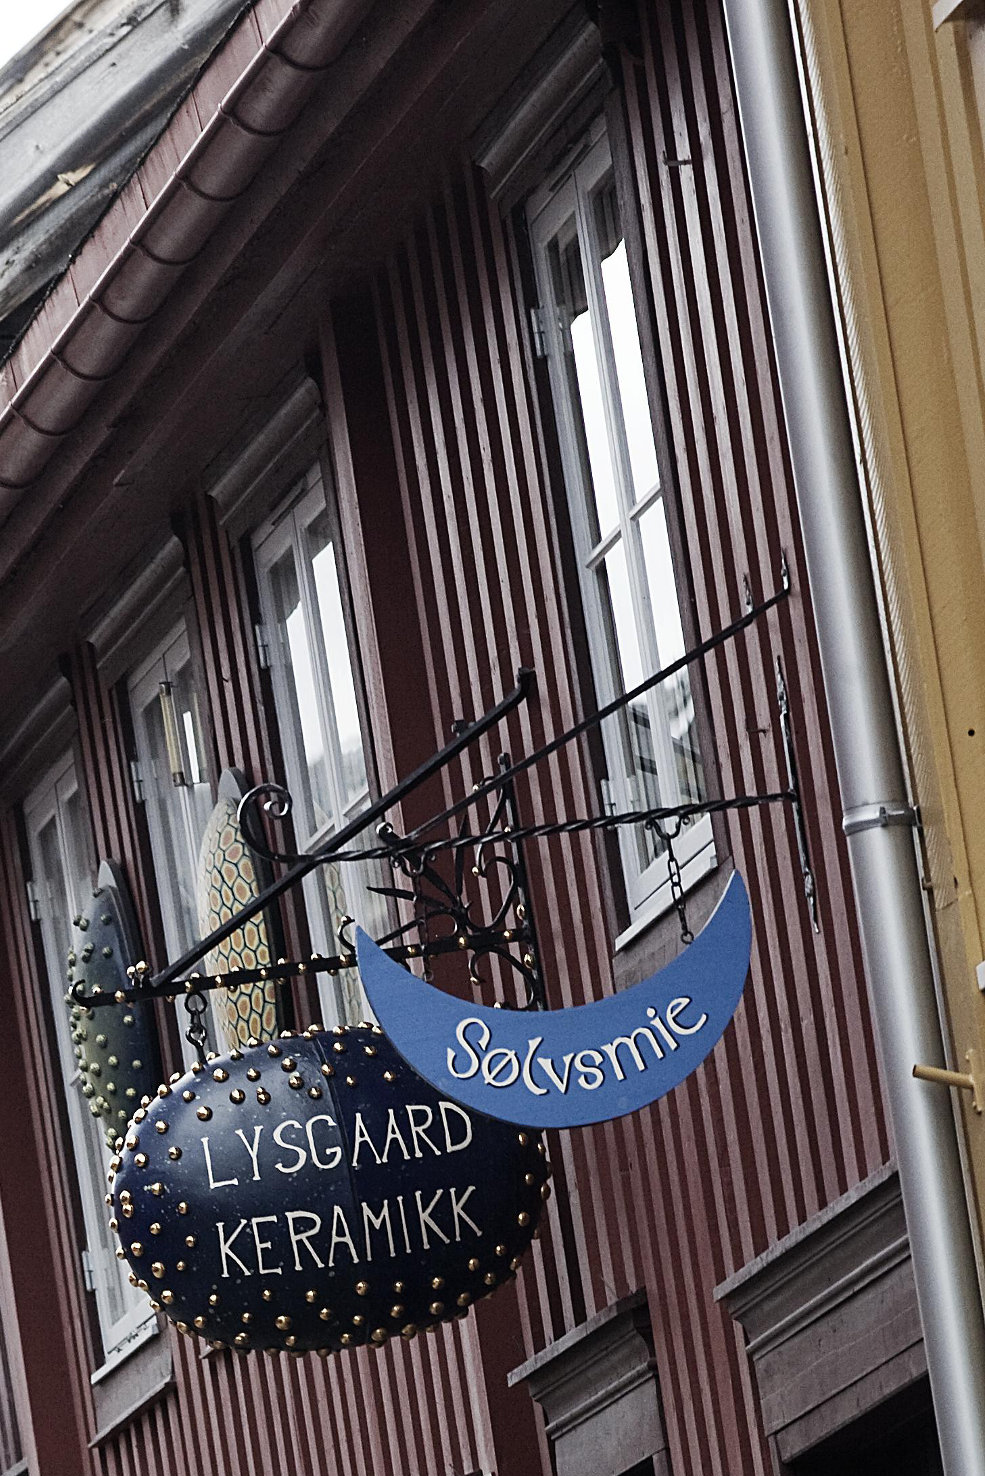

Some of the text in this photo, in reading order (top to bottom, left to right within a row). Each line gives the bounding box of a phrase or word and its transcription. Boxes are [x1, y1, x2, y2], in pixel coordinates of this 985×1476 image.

[447, 996, 709, 1096] Sølvsmie
[200, 1100, 473, 1189] LYSGAARD
[215, 1186, 484, 1279] KERAMIKK
